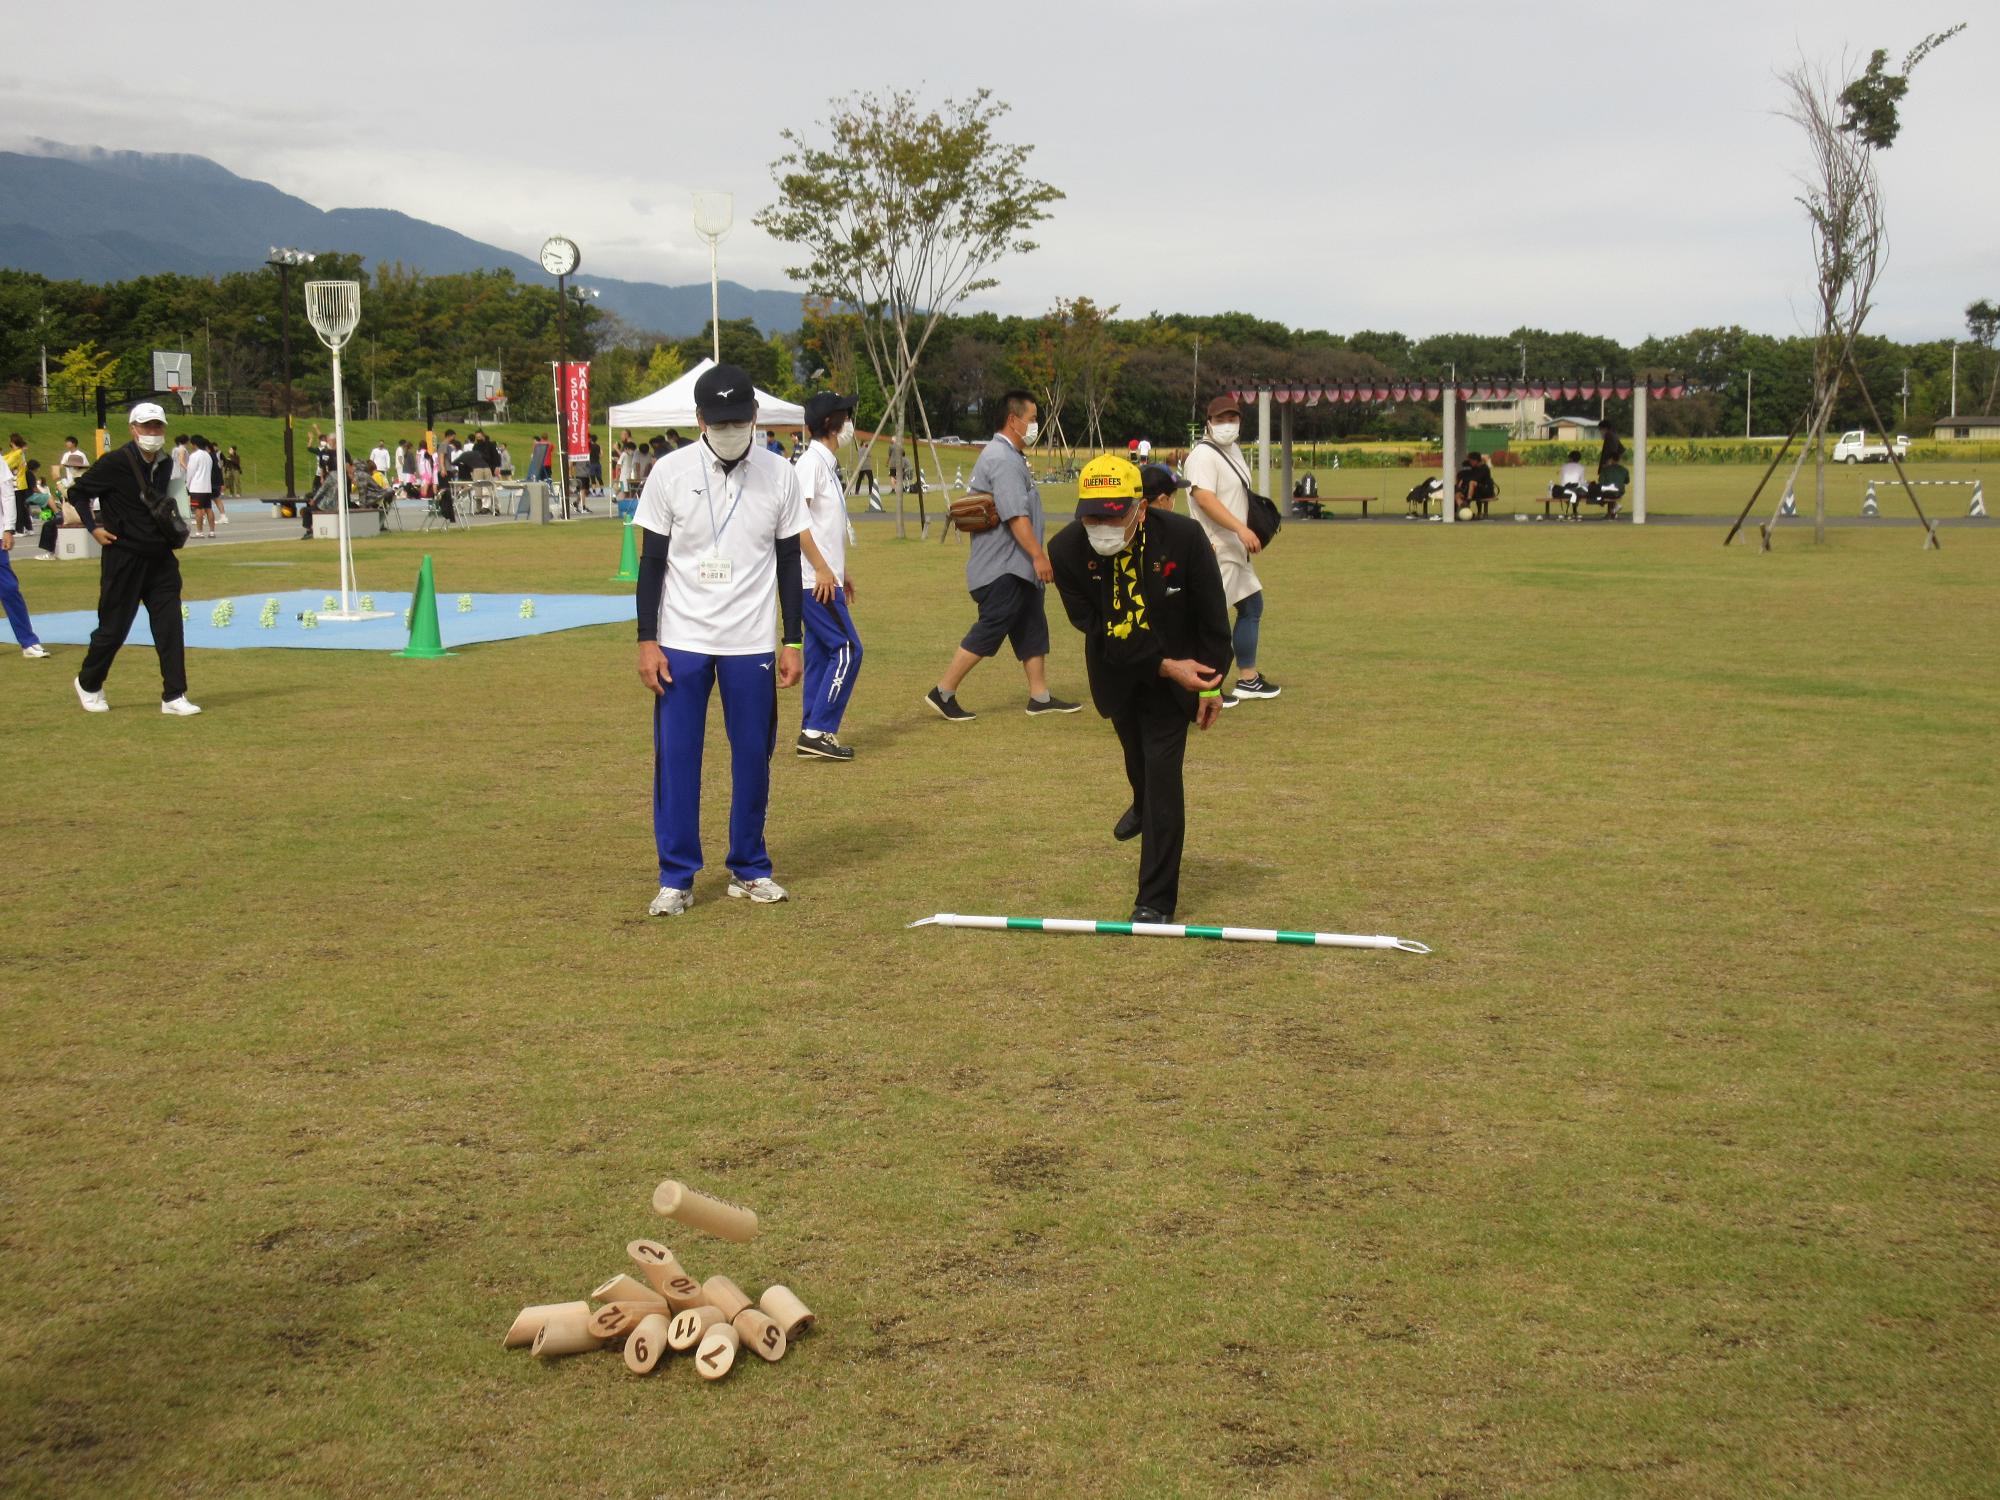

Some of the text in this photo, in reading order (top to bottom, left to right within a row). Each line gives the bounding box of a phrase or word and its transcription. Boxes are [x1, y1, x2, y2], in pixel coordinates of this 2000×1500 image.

[578, 366, 588, 401] KAI
[570, 377, 579, 444] SPORTS
[1083, 478, 1121, 490] QUEENBEES
[638, 1245, 666, 1261] 2
[670, 1278, 697, 1295] 10
[597, 1305, 626, 1330] 12
[674, 1316, 696, 1340] 11
[762, 1324, 780, 1351] 5
[700, 1343, 728, 1370] 7
